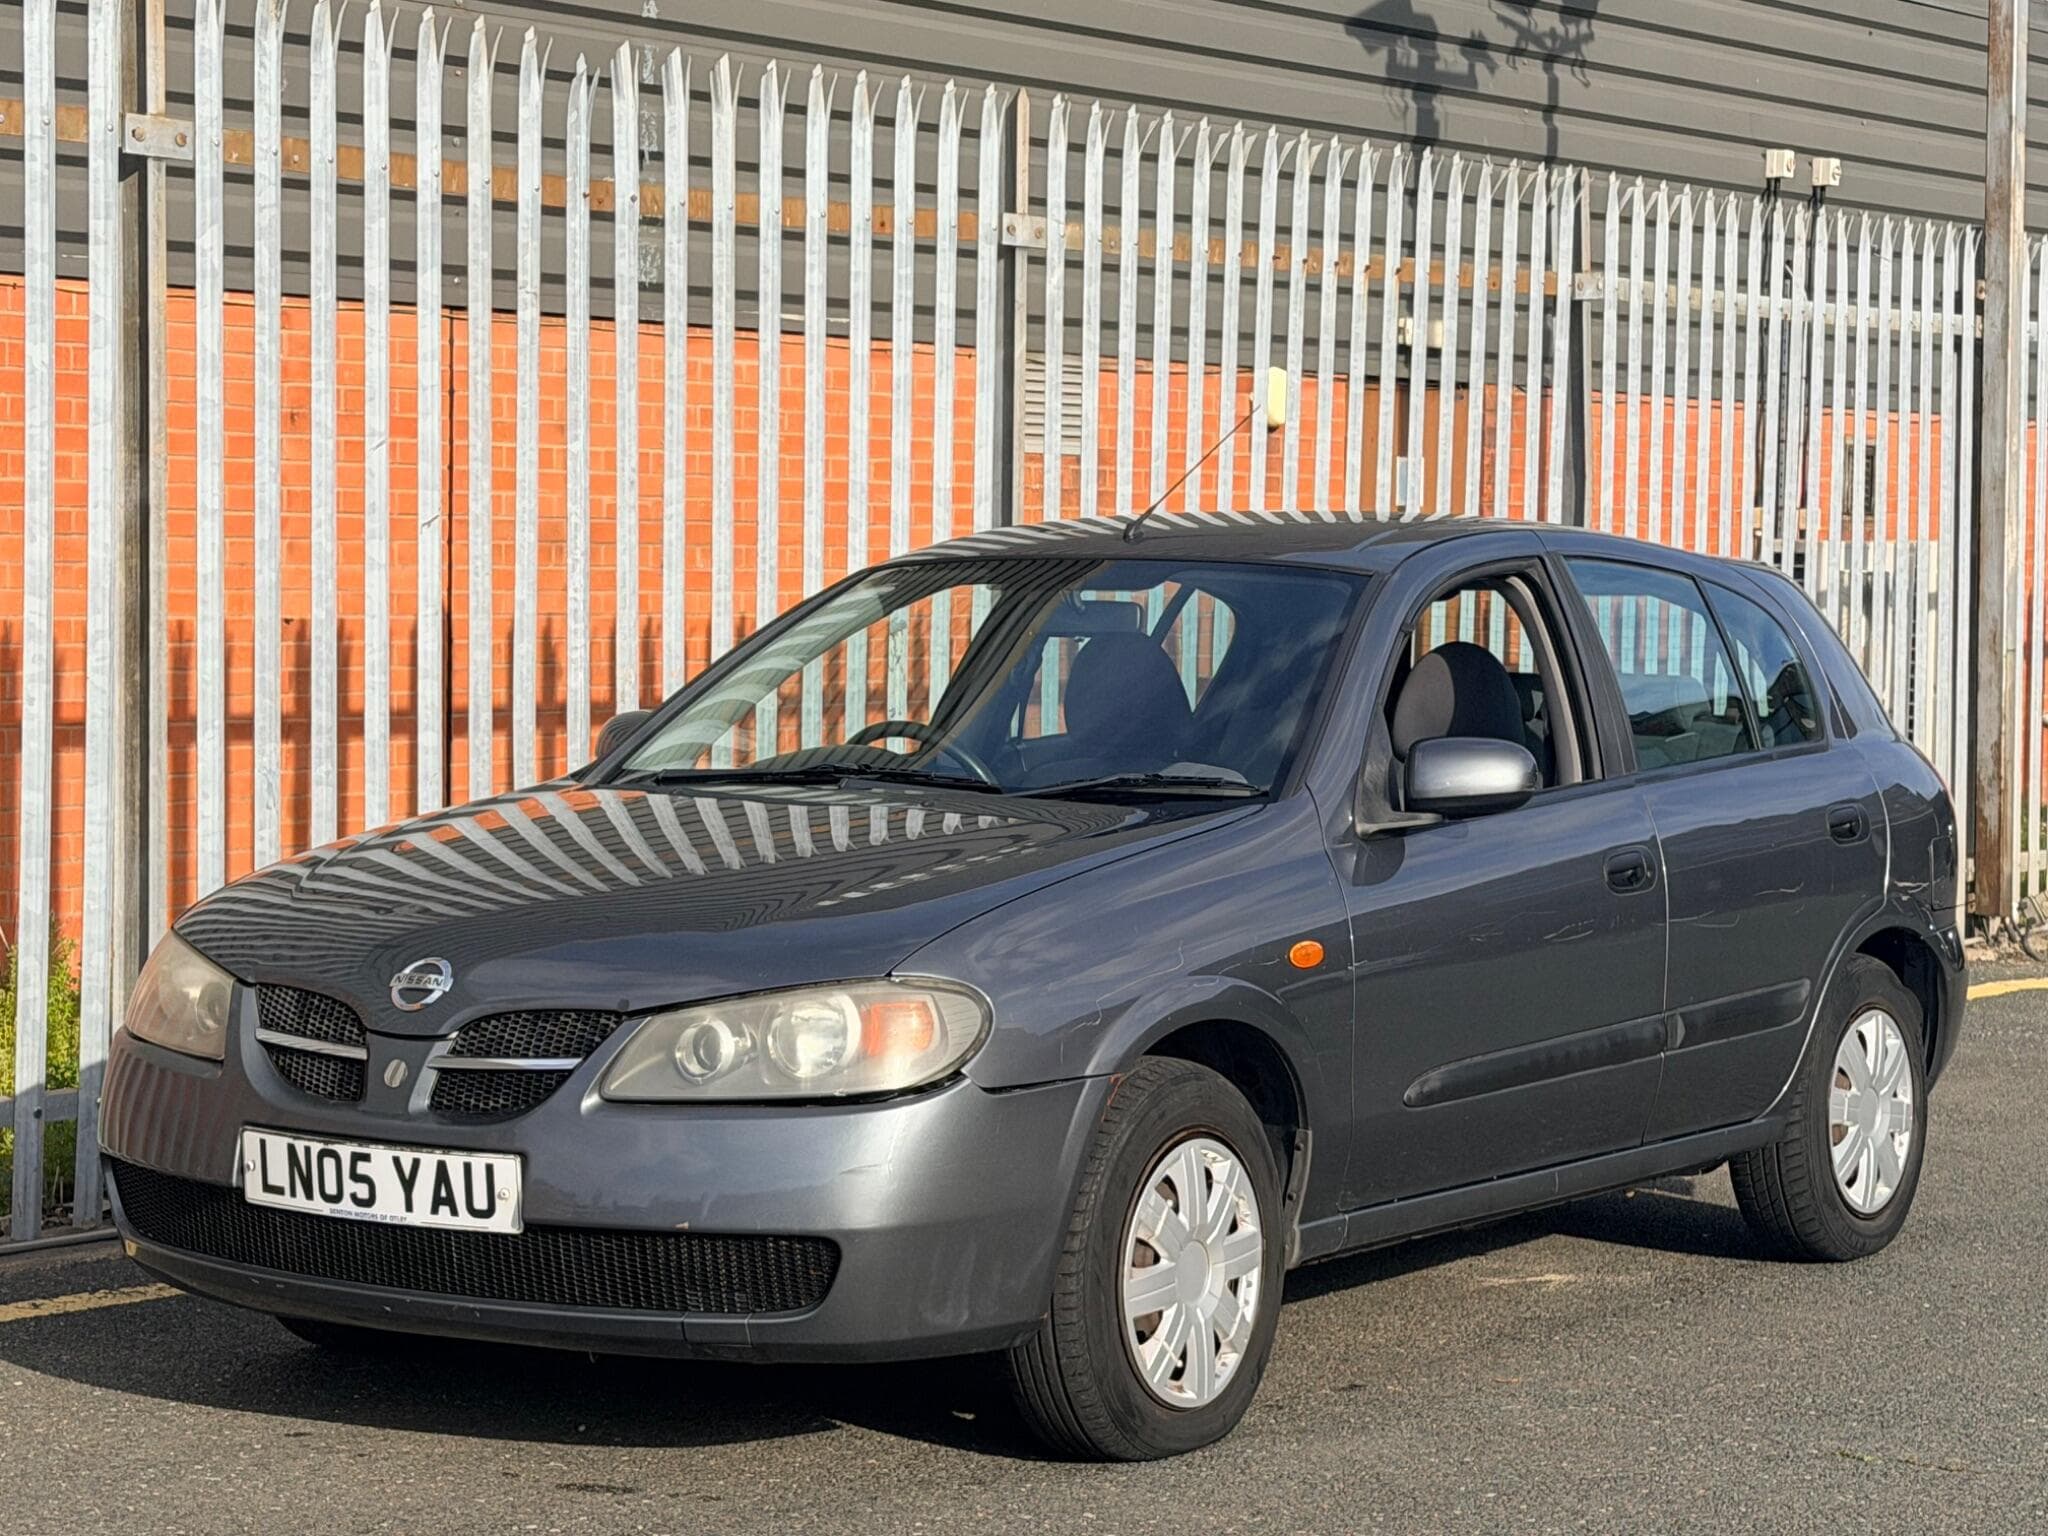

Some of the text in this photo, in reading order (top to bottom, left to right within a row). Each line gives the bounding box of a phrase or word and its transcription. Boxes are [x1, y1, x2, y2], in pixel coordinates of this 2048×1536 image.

[394, 975, 444, 986] NISSAN
[259, 1138, 496, 1219] LN05 YAU
